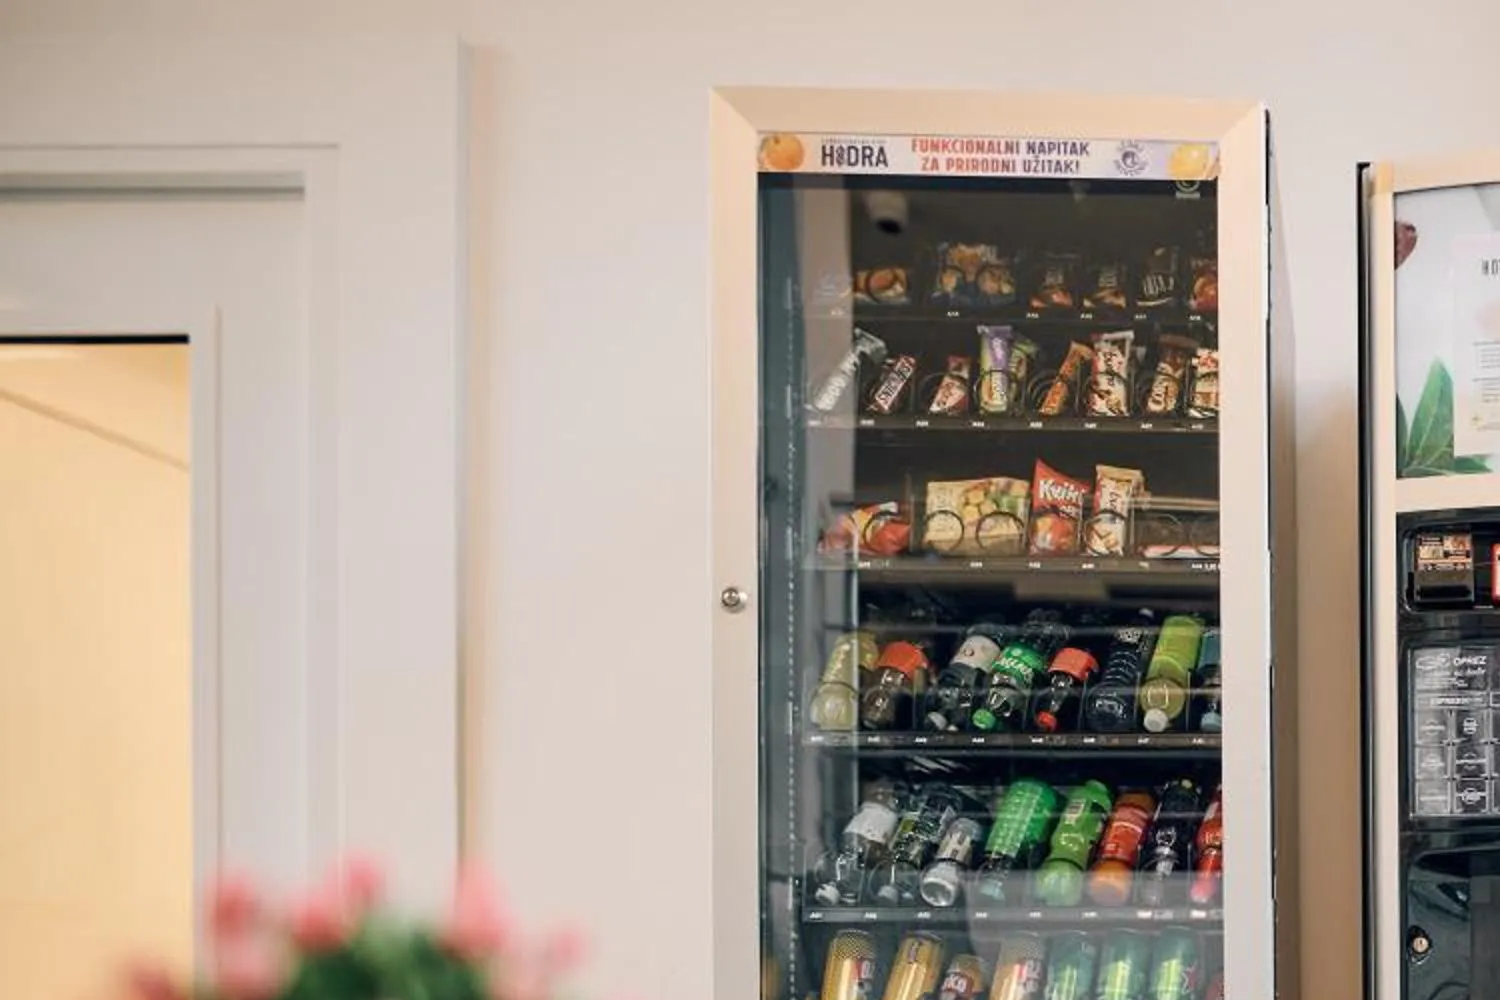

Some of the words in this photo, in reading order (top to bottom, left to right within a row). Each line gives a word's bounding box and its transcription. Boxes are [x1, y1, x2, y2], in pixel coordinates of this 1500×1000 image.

[911, 138, 1020, 155] FUNKCIONALNI
[1026, 141, 1090, 156] NAPITAK
[921, 157, 939, 172] ZA
[946, 158, 1016, 173] PRIRODNI
[1023, 156, 1080, 173] UŽITAK!
